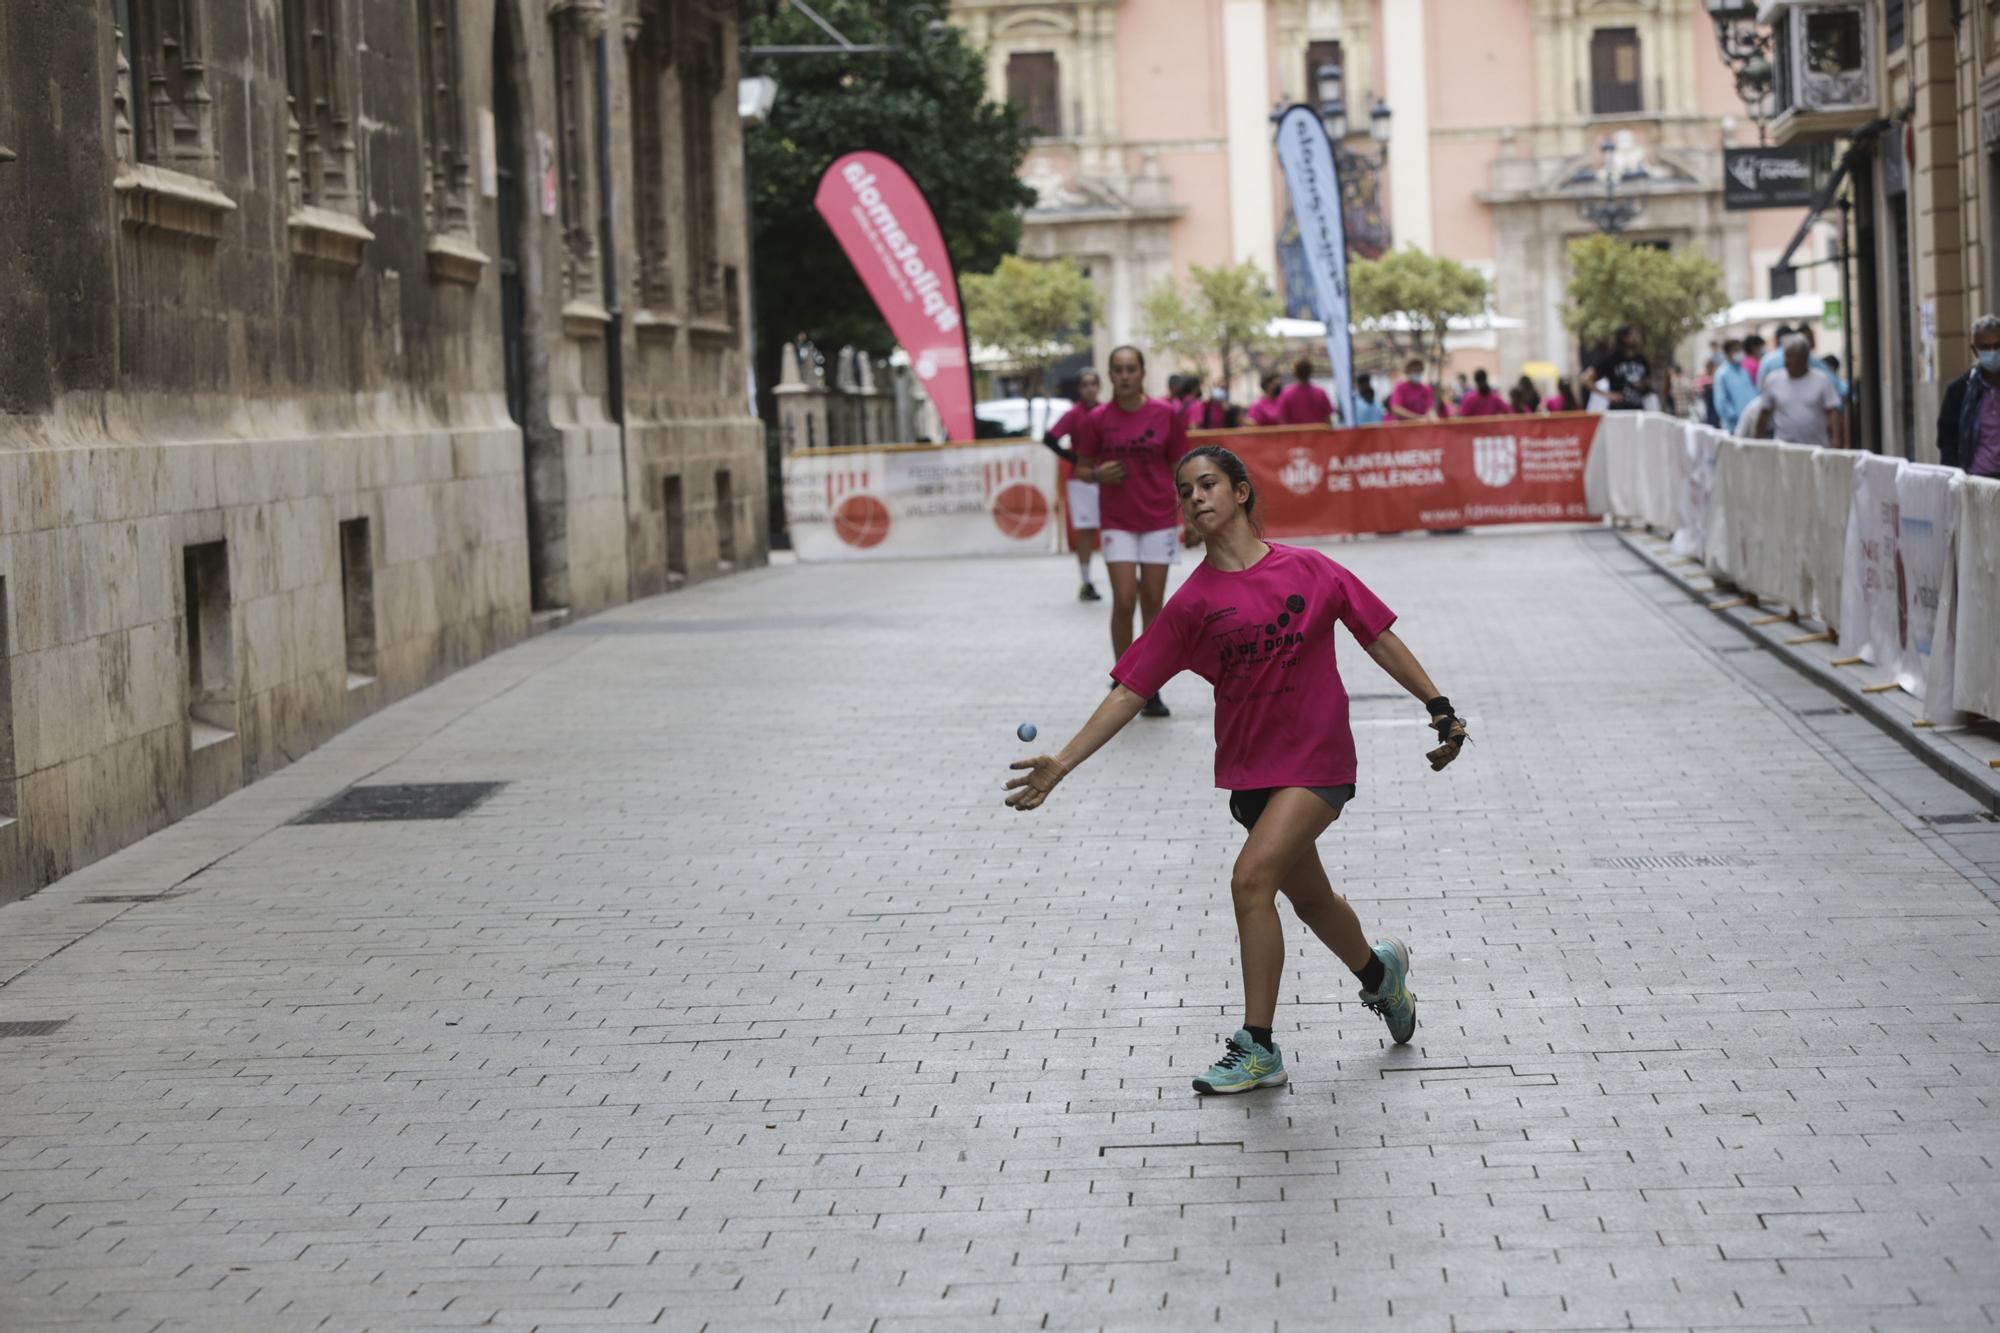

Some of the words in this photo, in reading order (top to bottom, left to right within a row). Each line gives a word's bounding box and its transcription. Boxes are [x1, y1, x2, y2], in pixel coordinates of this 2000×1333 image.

[1327, 448, 1444, 471] AJUNTAMENT
[1327, 474, 1354, 492] DE
[1239, 642, 1257, 656] DE
[1264, 632, 1304, 652] DONA
